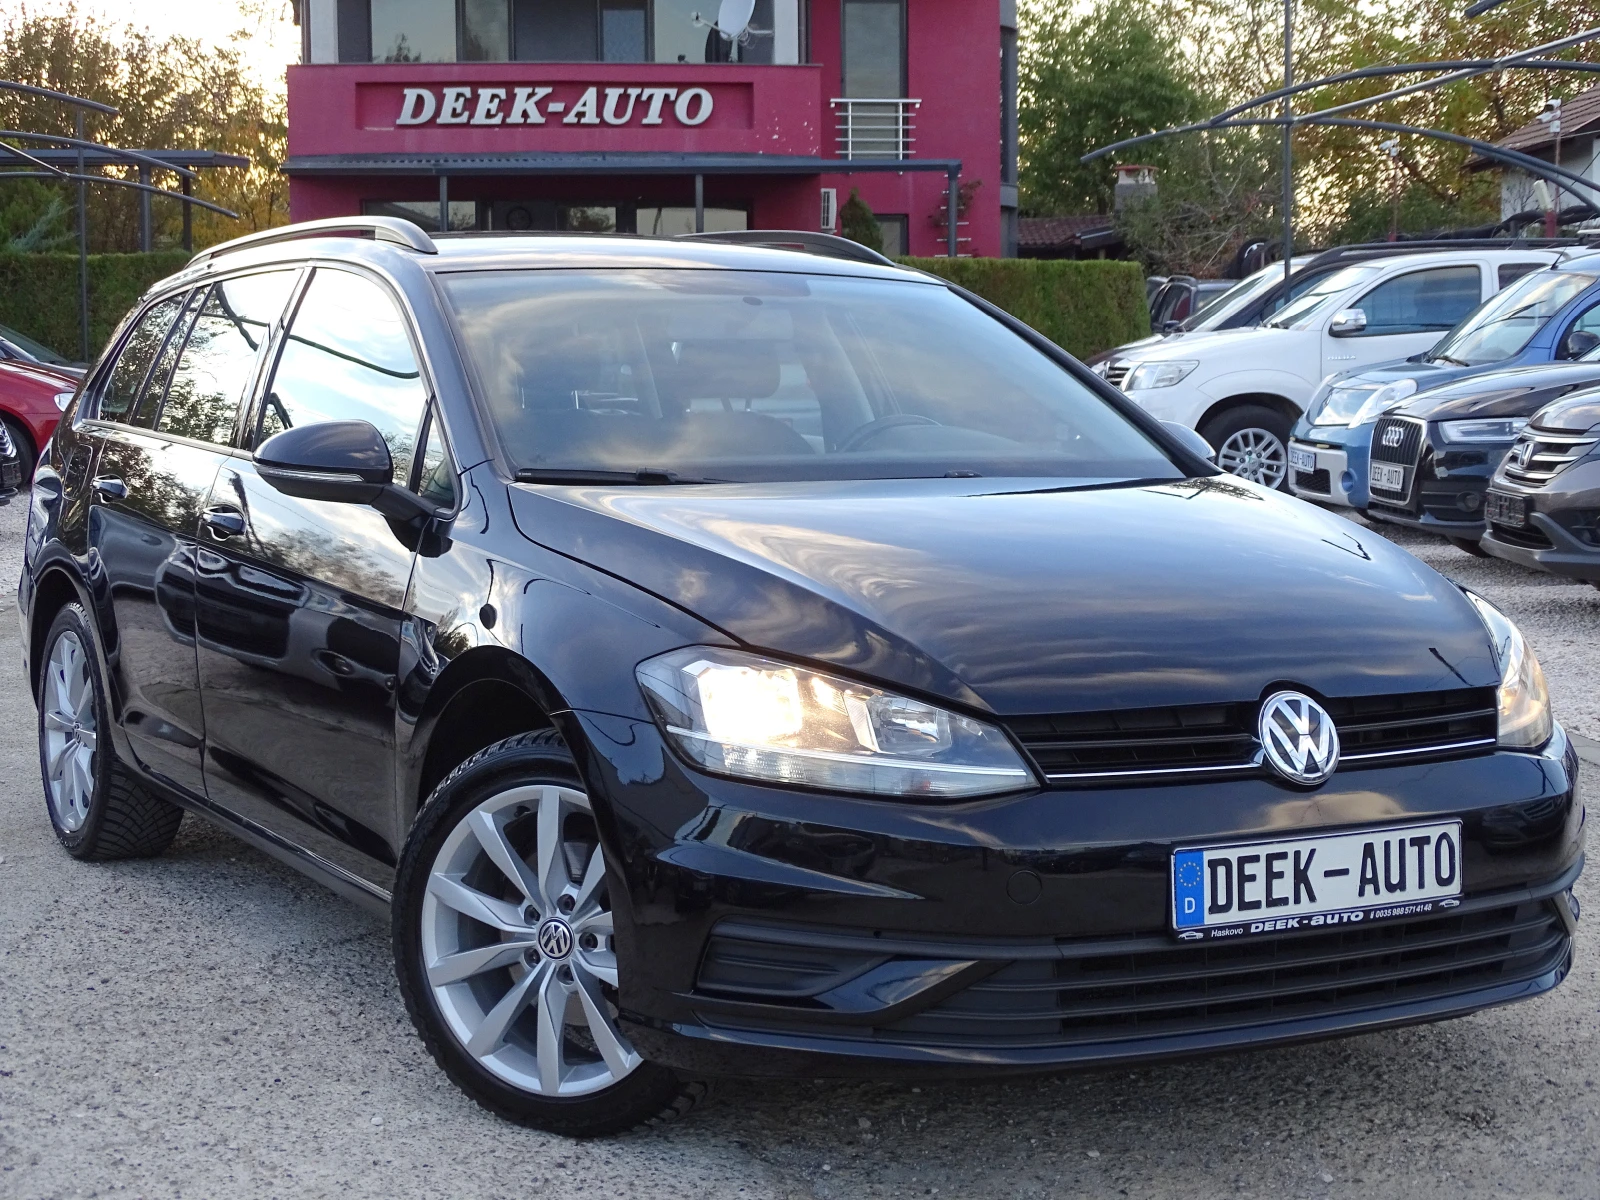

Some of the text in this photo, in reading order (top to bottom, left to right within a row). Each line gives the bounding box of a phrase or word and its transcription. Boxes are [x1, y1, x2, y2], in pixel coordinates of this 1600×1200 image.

[396, 87, 714, 126] DEEK-AUTO
[1184, 897, 1196, 914] D
[1211, 927, 1244, 937] Haskovo
